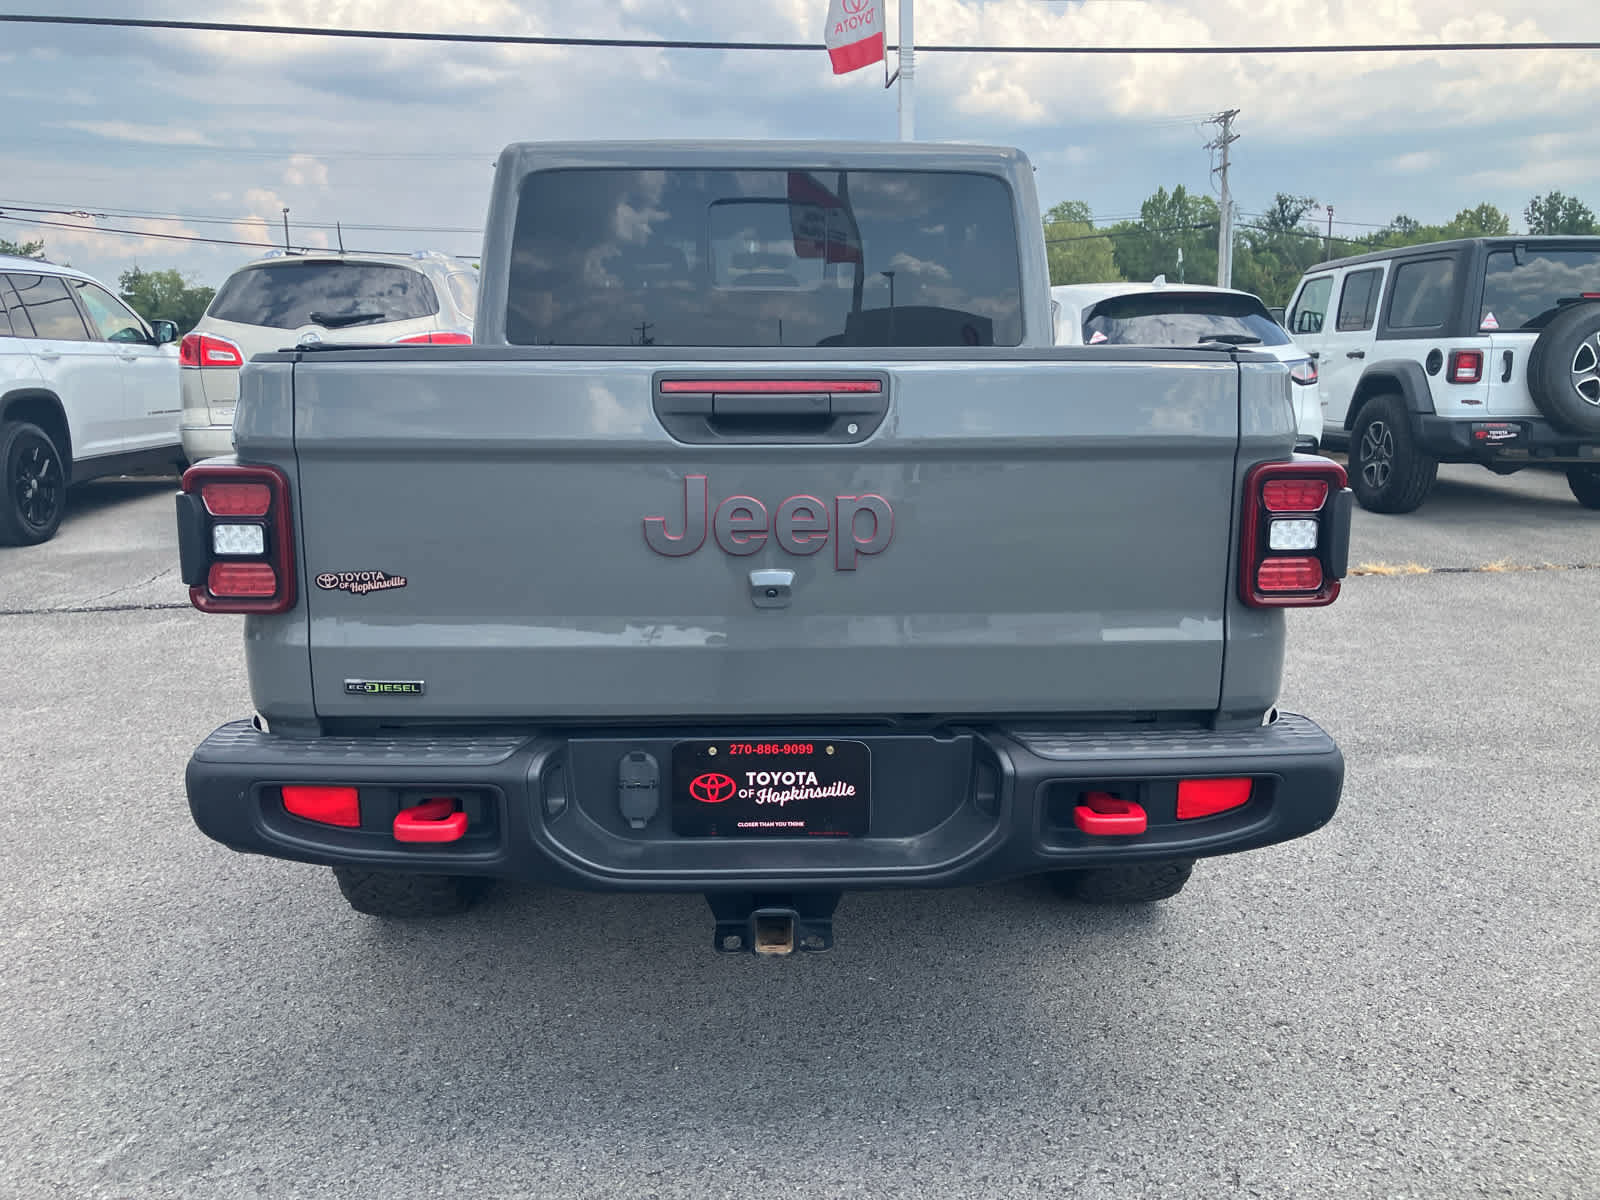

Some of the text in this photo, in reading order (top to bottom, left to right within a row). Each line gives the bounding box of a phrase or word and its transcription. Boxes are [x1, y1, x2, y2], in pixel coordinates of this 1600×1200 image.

[643, 474, 895, 571] Jeep
[338, 571, 385, 582] TOYOTA
[350, 576, 405, 593] Hopkinsville
[729, 743, 814, 755] 270-886-9099
[745, 771, 818, 786] TOYOTA
[738, 780, 856, 807] OF Hopkinsville
